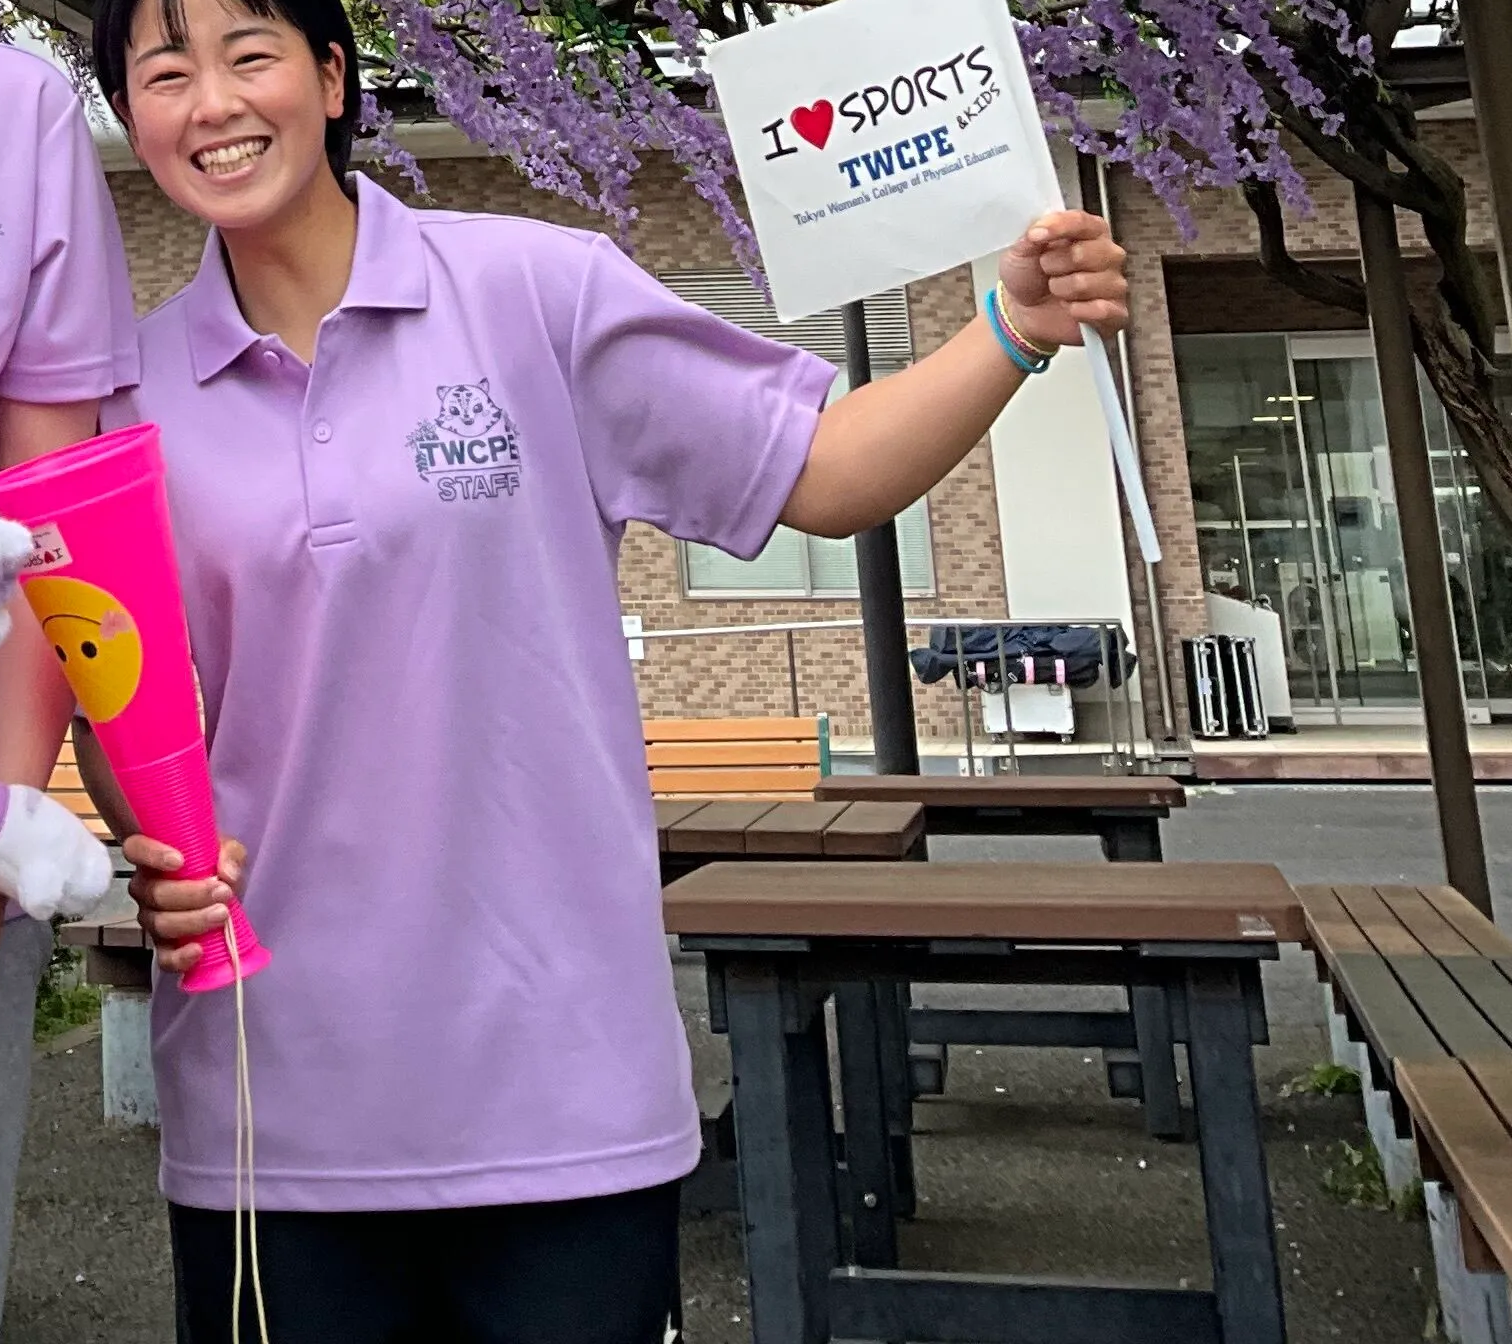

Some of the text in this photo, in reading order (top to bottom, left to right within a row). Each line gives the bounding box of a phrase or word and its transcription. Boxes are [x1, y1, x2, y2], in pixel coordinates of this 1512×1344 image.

[761, 45, 993, 161] I SPORTS
[793, 209, 826, 226] Tokyo
[826, 192, 871, 216] Women's
[872, 180, 909, 200] College
[922, 158, 963, 183] Physical
[965, 143, 1011, 167] Education
[838, 125, 955, 188] TWCPE
[419, 434, 519, 467] TWCPE
[438, 472, 520, 501] STAFF
